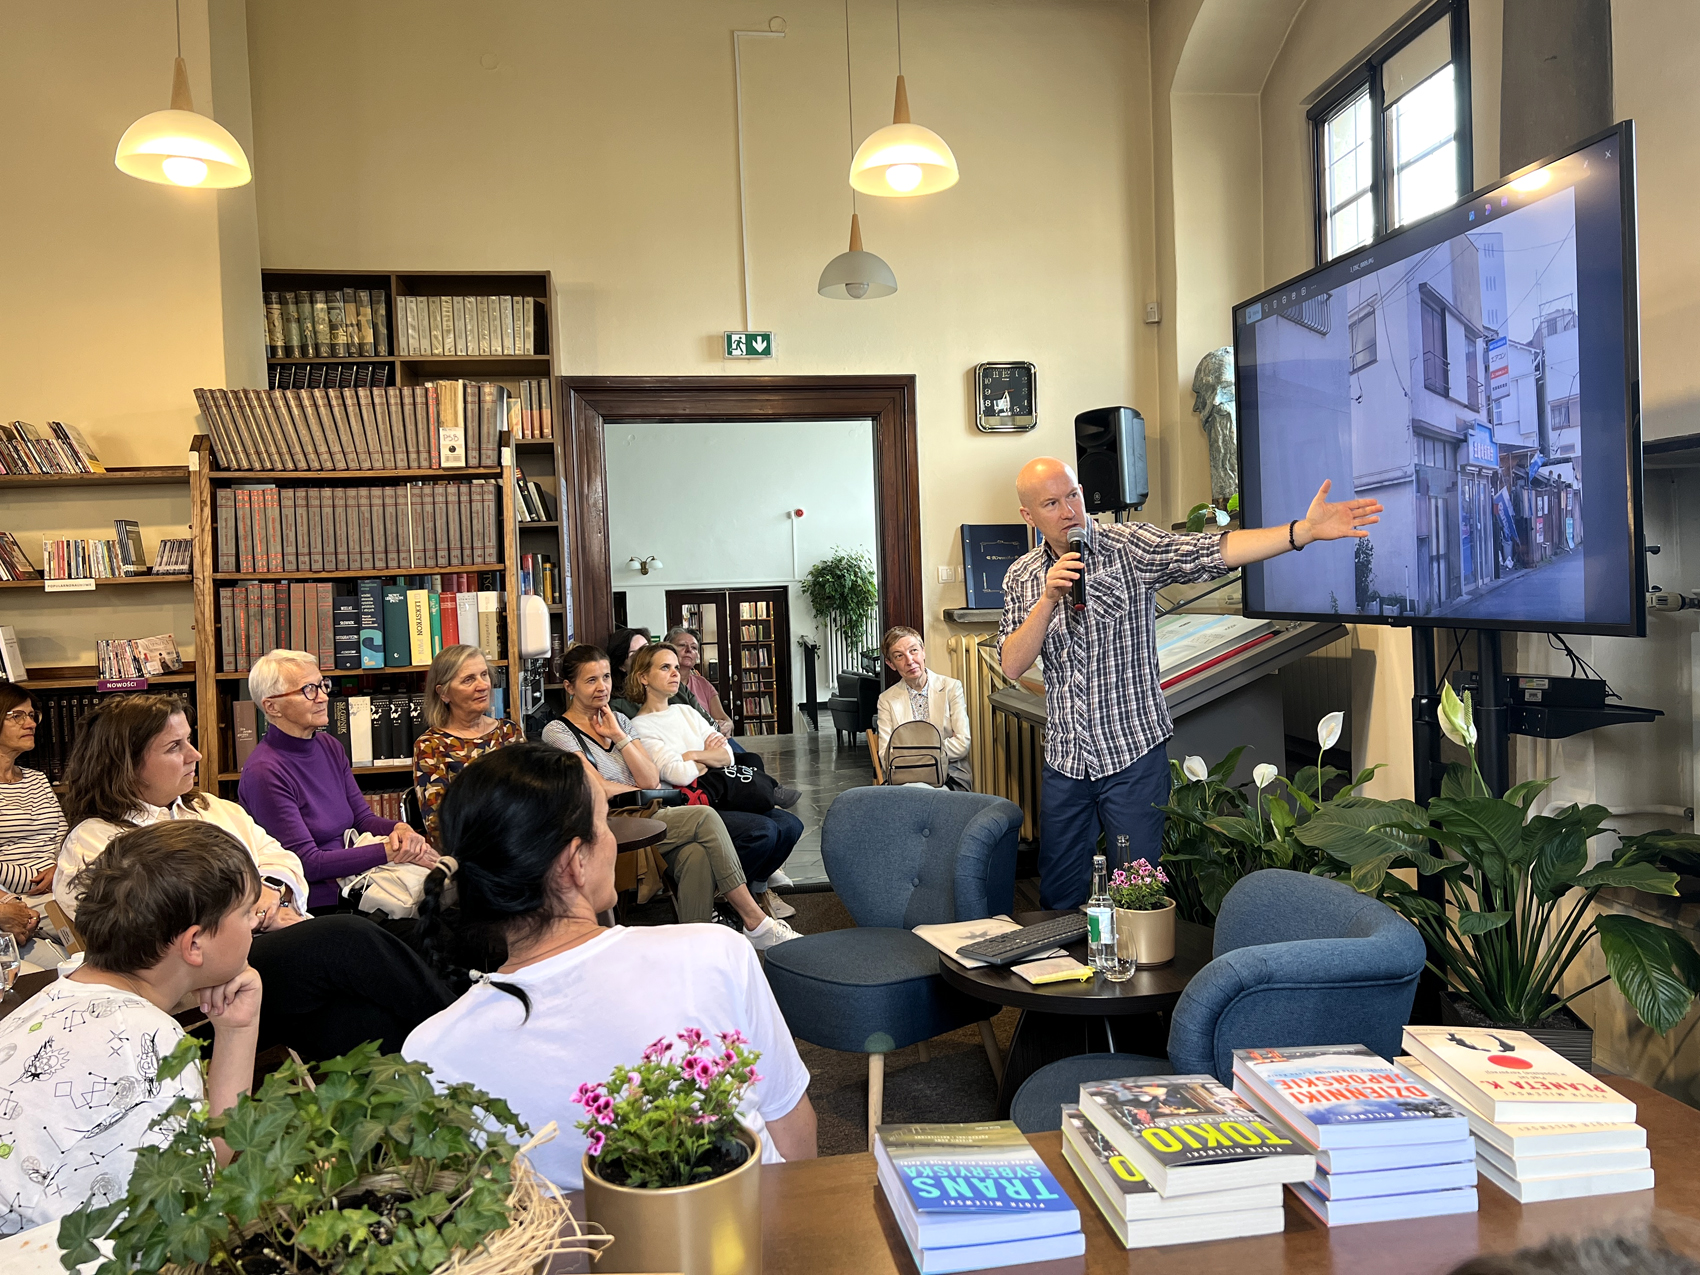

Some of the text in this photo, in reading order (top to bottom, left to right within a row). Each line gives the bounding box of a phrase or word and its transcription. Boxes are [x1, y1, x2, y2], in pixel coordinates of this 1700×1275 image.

[415, 601, 423, 636] LEKSYKON
[1274, 1074, 1408, 1091] JAPOŃSKIE
[1479, 1080, 1607, 1093] PLANETA K.
[1288, 1085, 1428, 1104] DZIENNIKI
[1337, 1110, 1435, 1121] PIOTR MILEWSKI
[1142, 1122, 1292, 1153] TOKIO
[1185, 1147, 1243, 1158] MILEWSKI
[903, 1165, 1041, 1178] SYBERYJSKA
[911, 1177, 1059, 1200] TRANS
[1010, 1201, 1045, 1209] PIOTR
